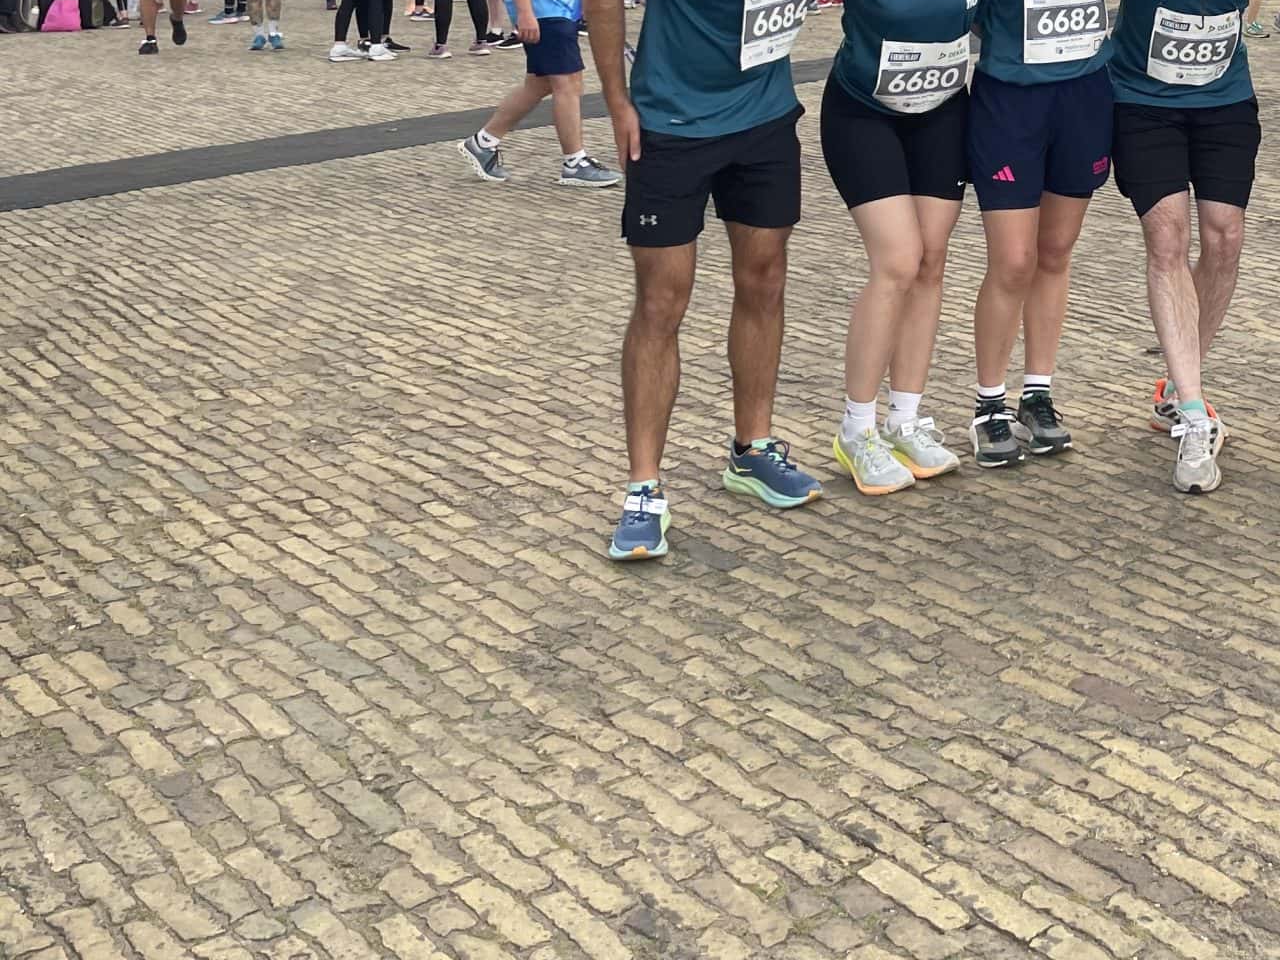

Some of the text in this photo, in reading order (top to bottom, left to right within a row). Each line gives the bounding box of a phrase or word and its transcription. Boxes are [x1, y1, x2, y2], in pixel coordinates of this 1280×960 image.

[753, 0, 808, 37] 6684
[1037, 5, 1101, 35] 6682
[1161, 40, 1229, 63] 6683
[887, 68, 960, 94] 6680
